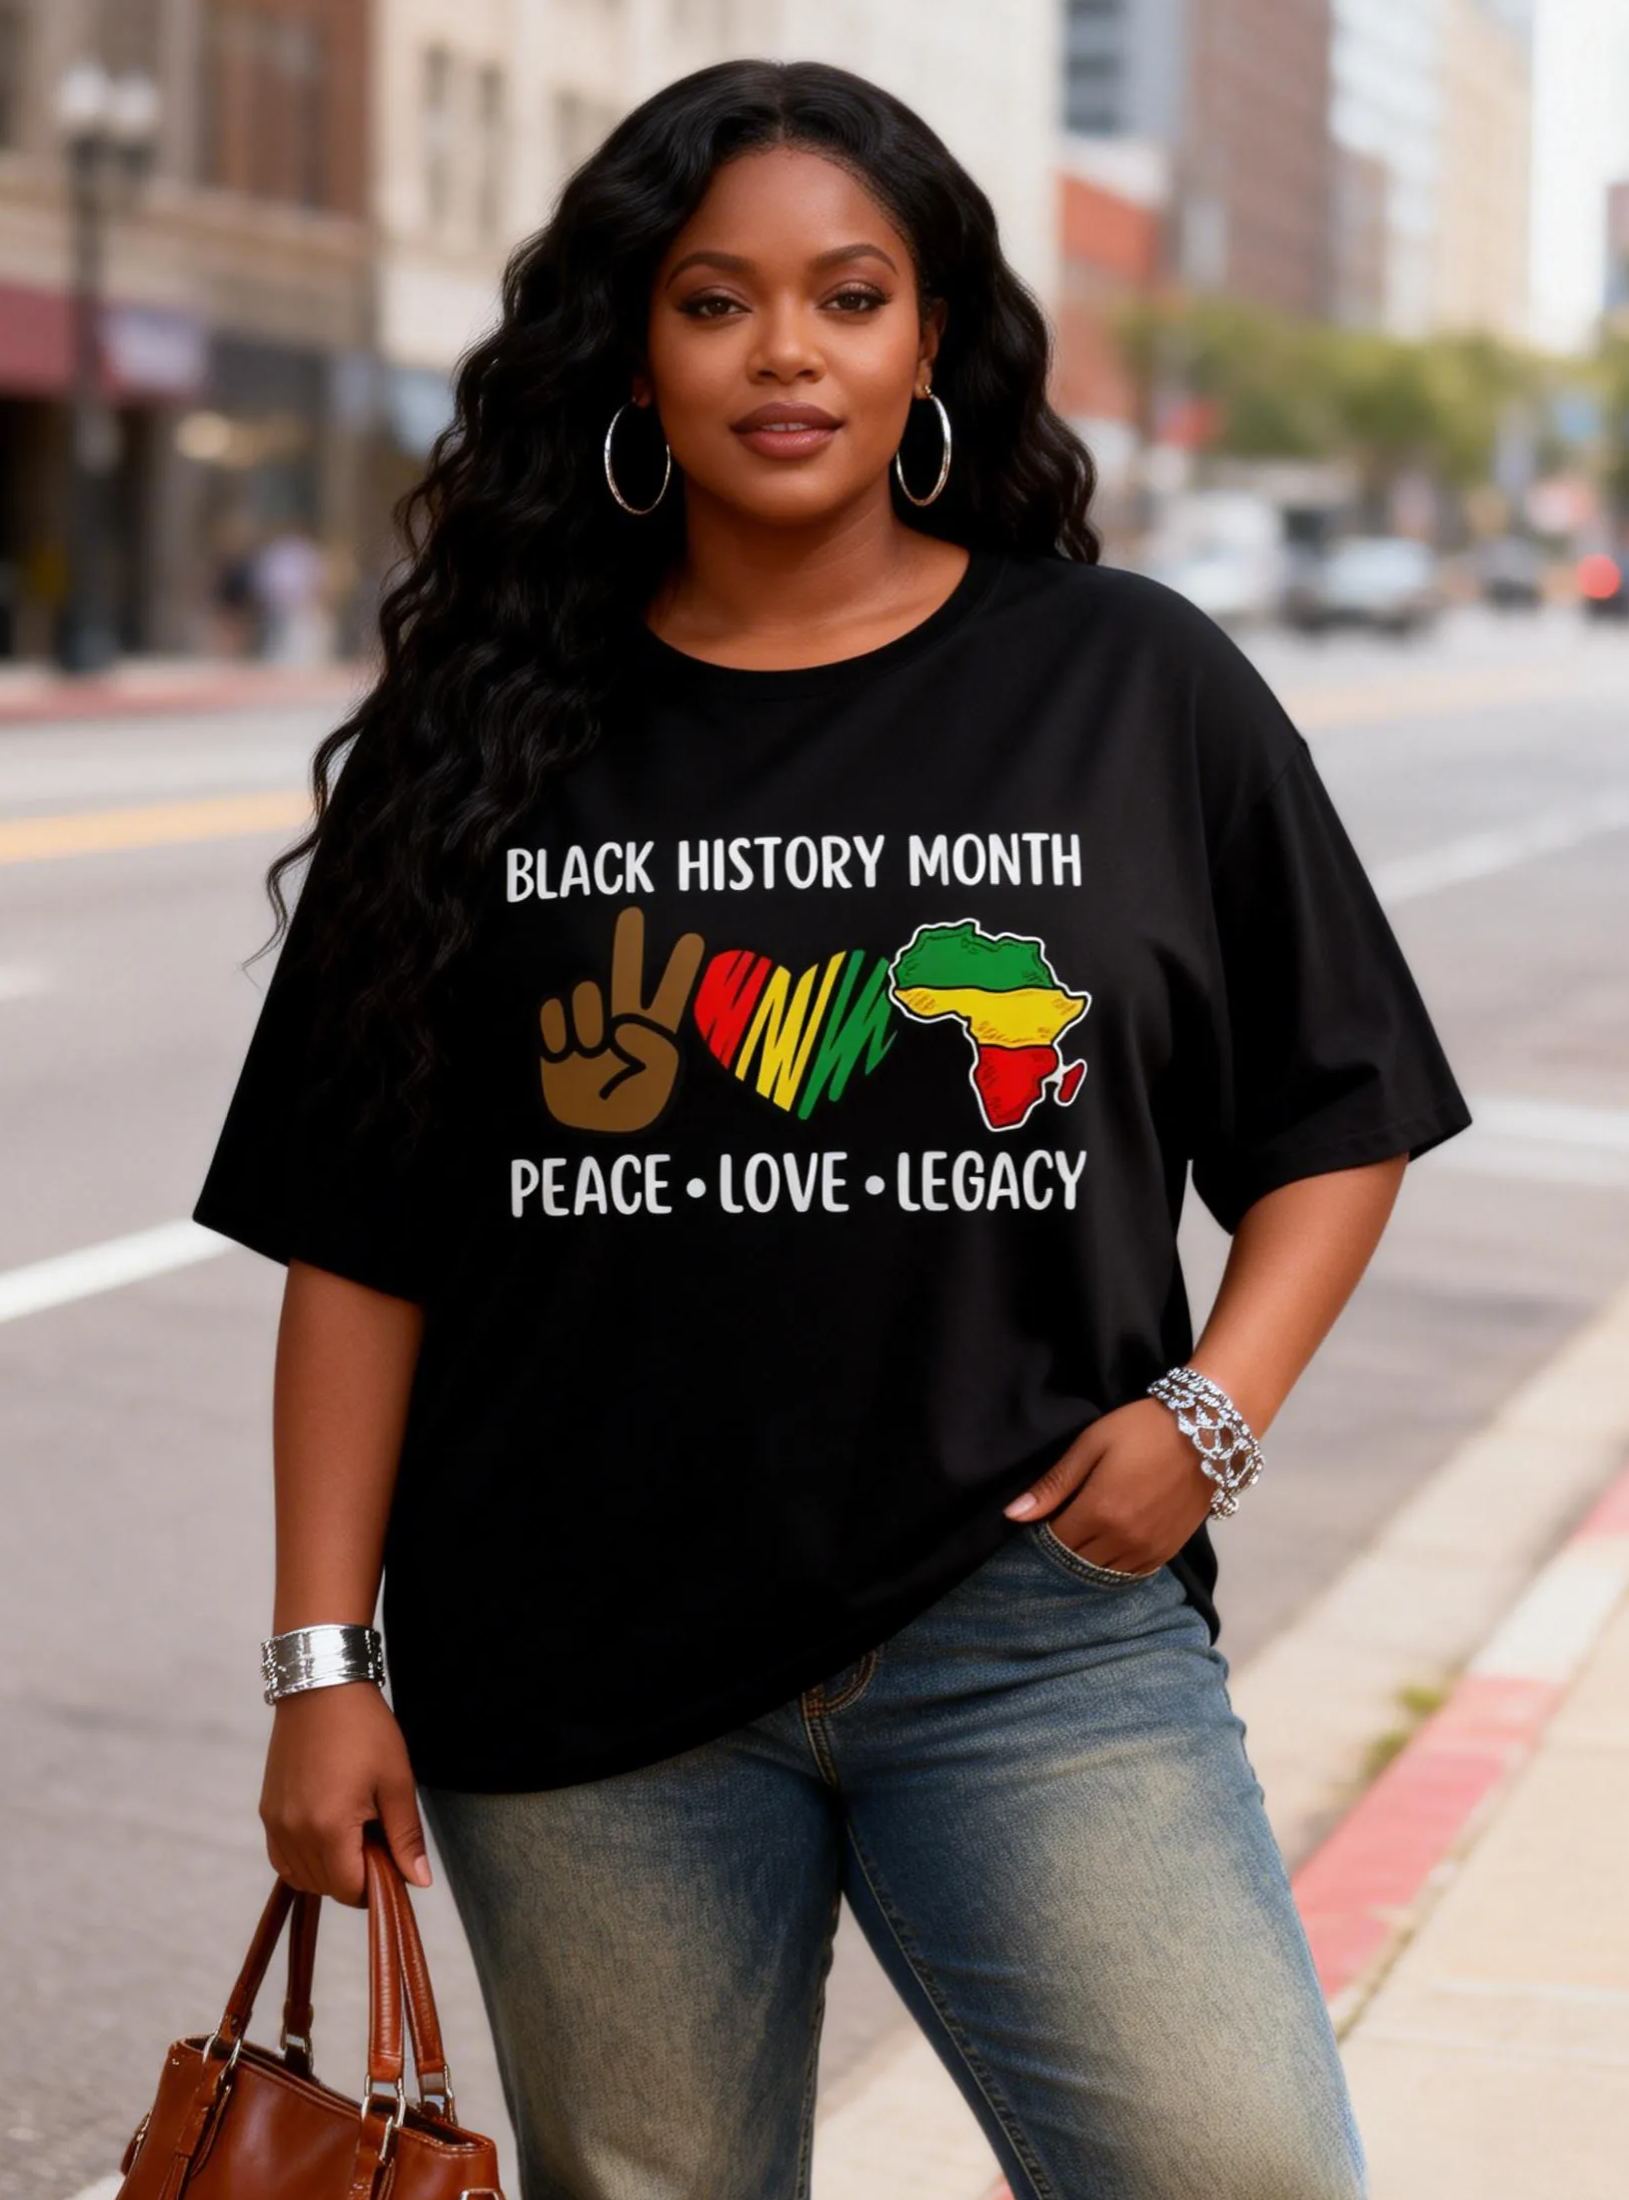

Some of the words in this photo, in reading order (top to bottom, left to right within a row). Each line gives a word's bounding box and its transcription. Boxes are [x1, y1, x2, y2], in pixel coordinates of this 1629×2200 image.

[506, 840, 655, 903] BLACK
[678, 834, 885, 892] HISTORY
[908, 832, 1082, 887] MONTH
[511, 1154, 673, 1218] PEACE
[719, 1151, 850, 1214] LOVE
[897, 1149, 1087, 1212] LEGACY
